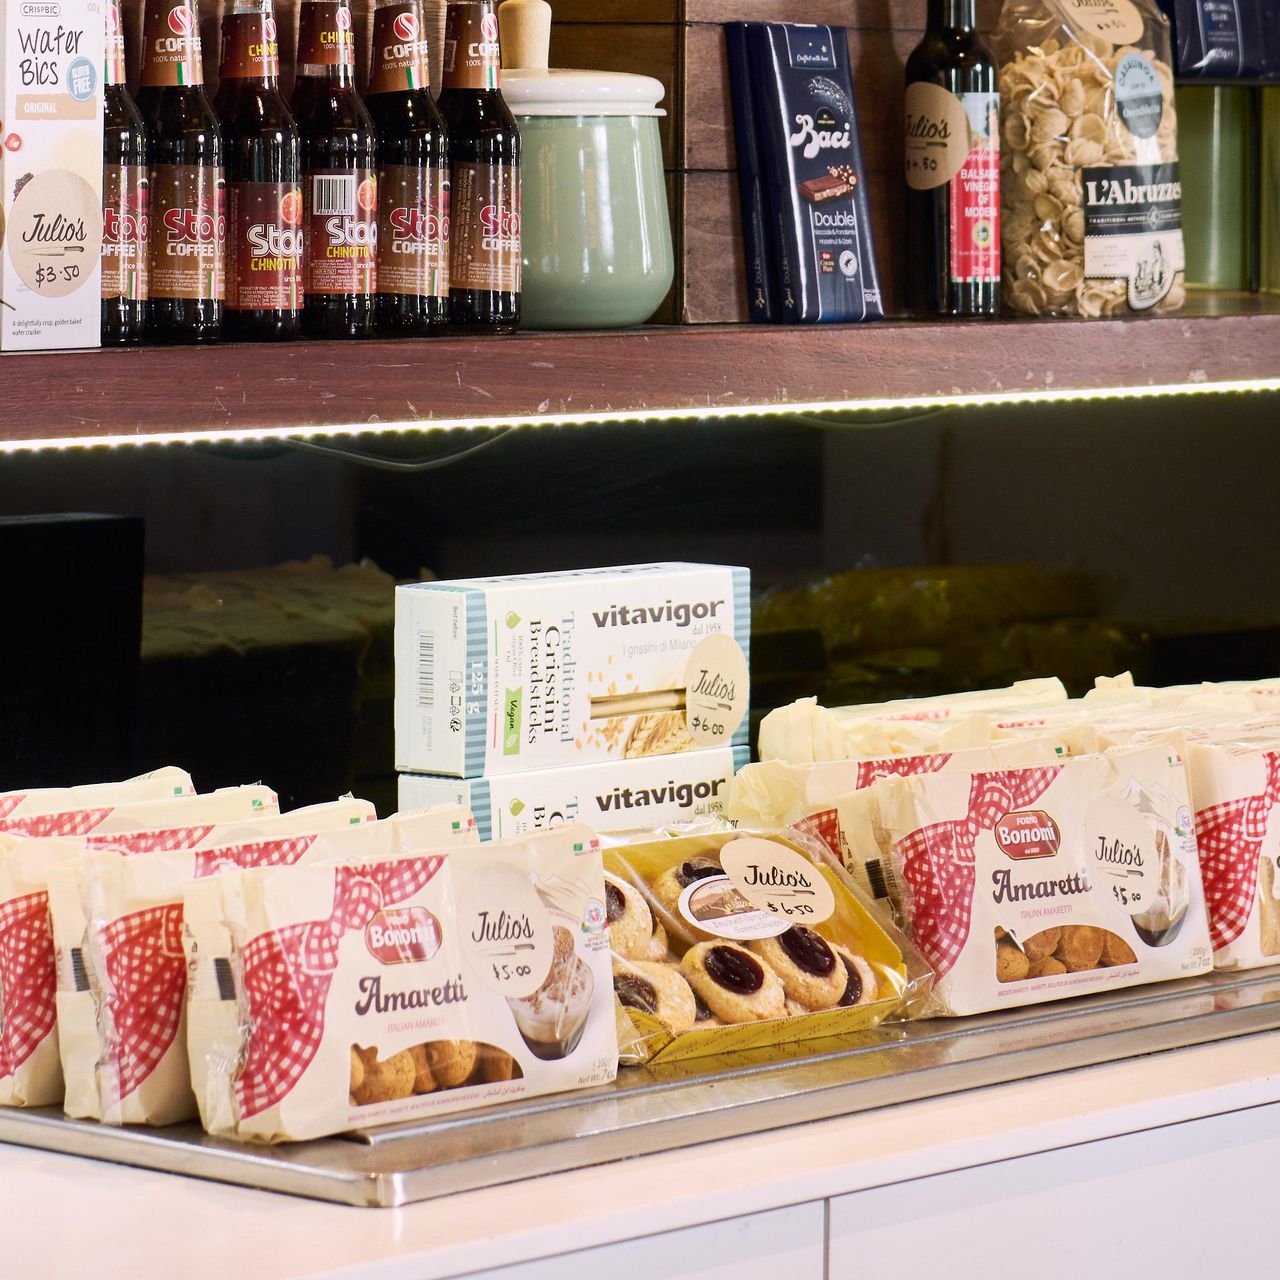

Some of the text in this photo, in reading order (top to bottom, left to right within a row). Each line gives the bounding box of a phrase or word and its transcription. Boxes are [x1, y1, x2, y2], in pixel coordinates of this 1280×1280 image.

[22, 4, 58, 15] CRISPBIC
[17, 24, 84, 56] Wafer
[18, 56, 60, 86] Bics
[74, 76, 92, 96] FREE
[23, 102, 57, 114] ORIGINAL
[790, 114, 851, 159] Baci
[905, 113, 952, 140] Julio's
[977, 194, 990, 205] OF
[22, 213, 88, 244] Julio's
[814, 210, 856, 227] Double
[166, 241, 215, 257] COFFEE
[326, 245, 369, 259] CHINOTTO
[391, 239, 439, 256] COFFEE
[34, 263, 81, 289] $3.50
[250, 256, 297, 272] CHINOTTO
[18, 319, 42, 330] delightfully
[592, 599, 725, 629] vitavigor
[691, 623, 704, 636] dal
[627, 640, 658, 659] grissini
[669, 637, 697, 651] Milano
[471, 660, 484, 696] 125
[528, 620, 544, 744] Breadsticks
[543, 625, 561, 733] Grissini
[560, 610, 577, 743] Traditional
[690, 669, 737, 702] Julio's
[506, 699, 518, 731] Vegan
[691, 714, 725, 736] $6.00
[595, 776, 727, 811] vitavigor
[694, 803, 706, 816] dal
[1016, 815, 1039, 826] FORNO
[998, 821, 1056, 846] Bonomi
[1094, 836, 1145, 867] Julio's
[743, 864, 812, 888] Julio's
[991, 867, 1093, 905] Amaretti
[1112, 884, 1142, 906] $5.00
[1020, 904, 1073, 920] ITALIAN AMARETTI
[471, 909, 535, 943] Julio's
[491, 963, 532, 981] $5.00
[354, 972, 469, 1016] Amaretti
[387, 1022, 414, 1034] ITALIAN
